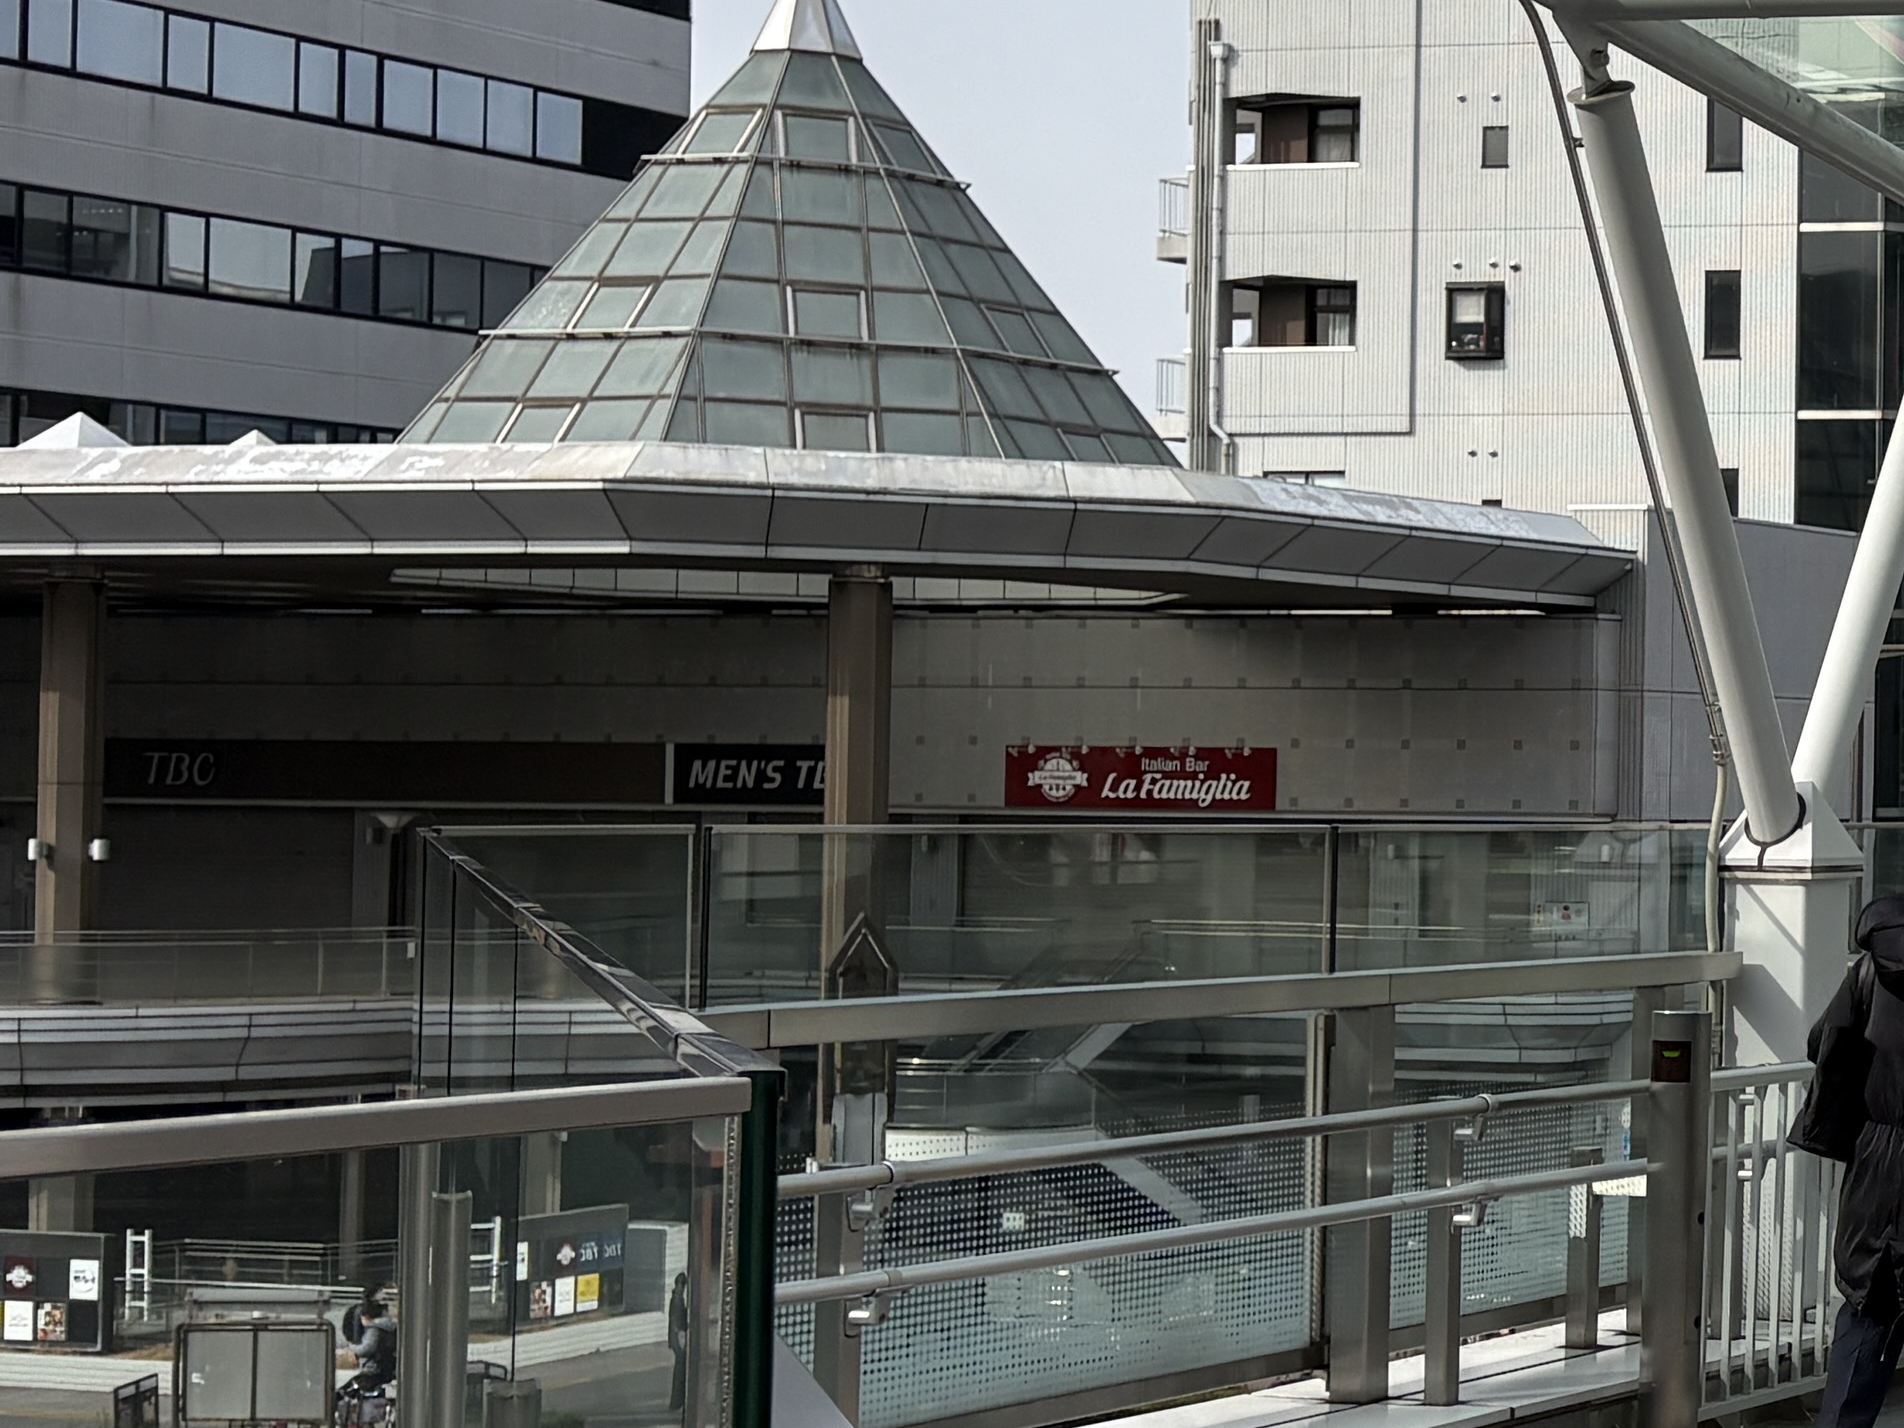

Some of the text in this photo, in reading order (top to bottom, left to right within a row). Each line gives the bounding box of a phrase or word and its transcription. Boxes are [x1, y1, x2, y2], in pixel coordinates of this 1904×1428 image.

[142, 752, 216, 786] TBC
[688, 759, 785, 789] MEN'S
[1141, 756, 1210, 772] Italian Bar
[1101, 772, 1252, 808] La Famiglia
